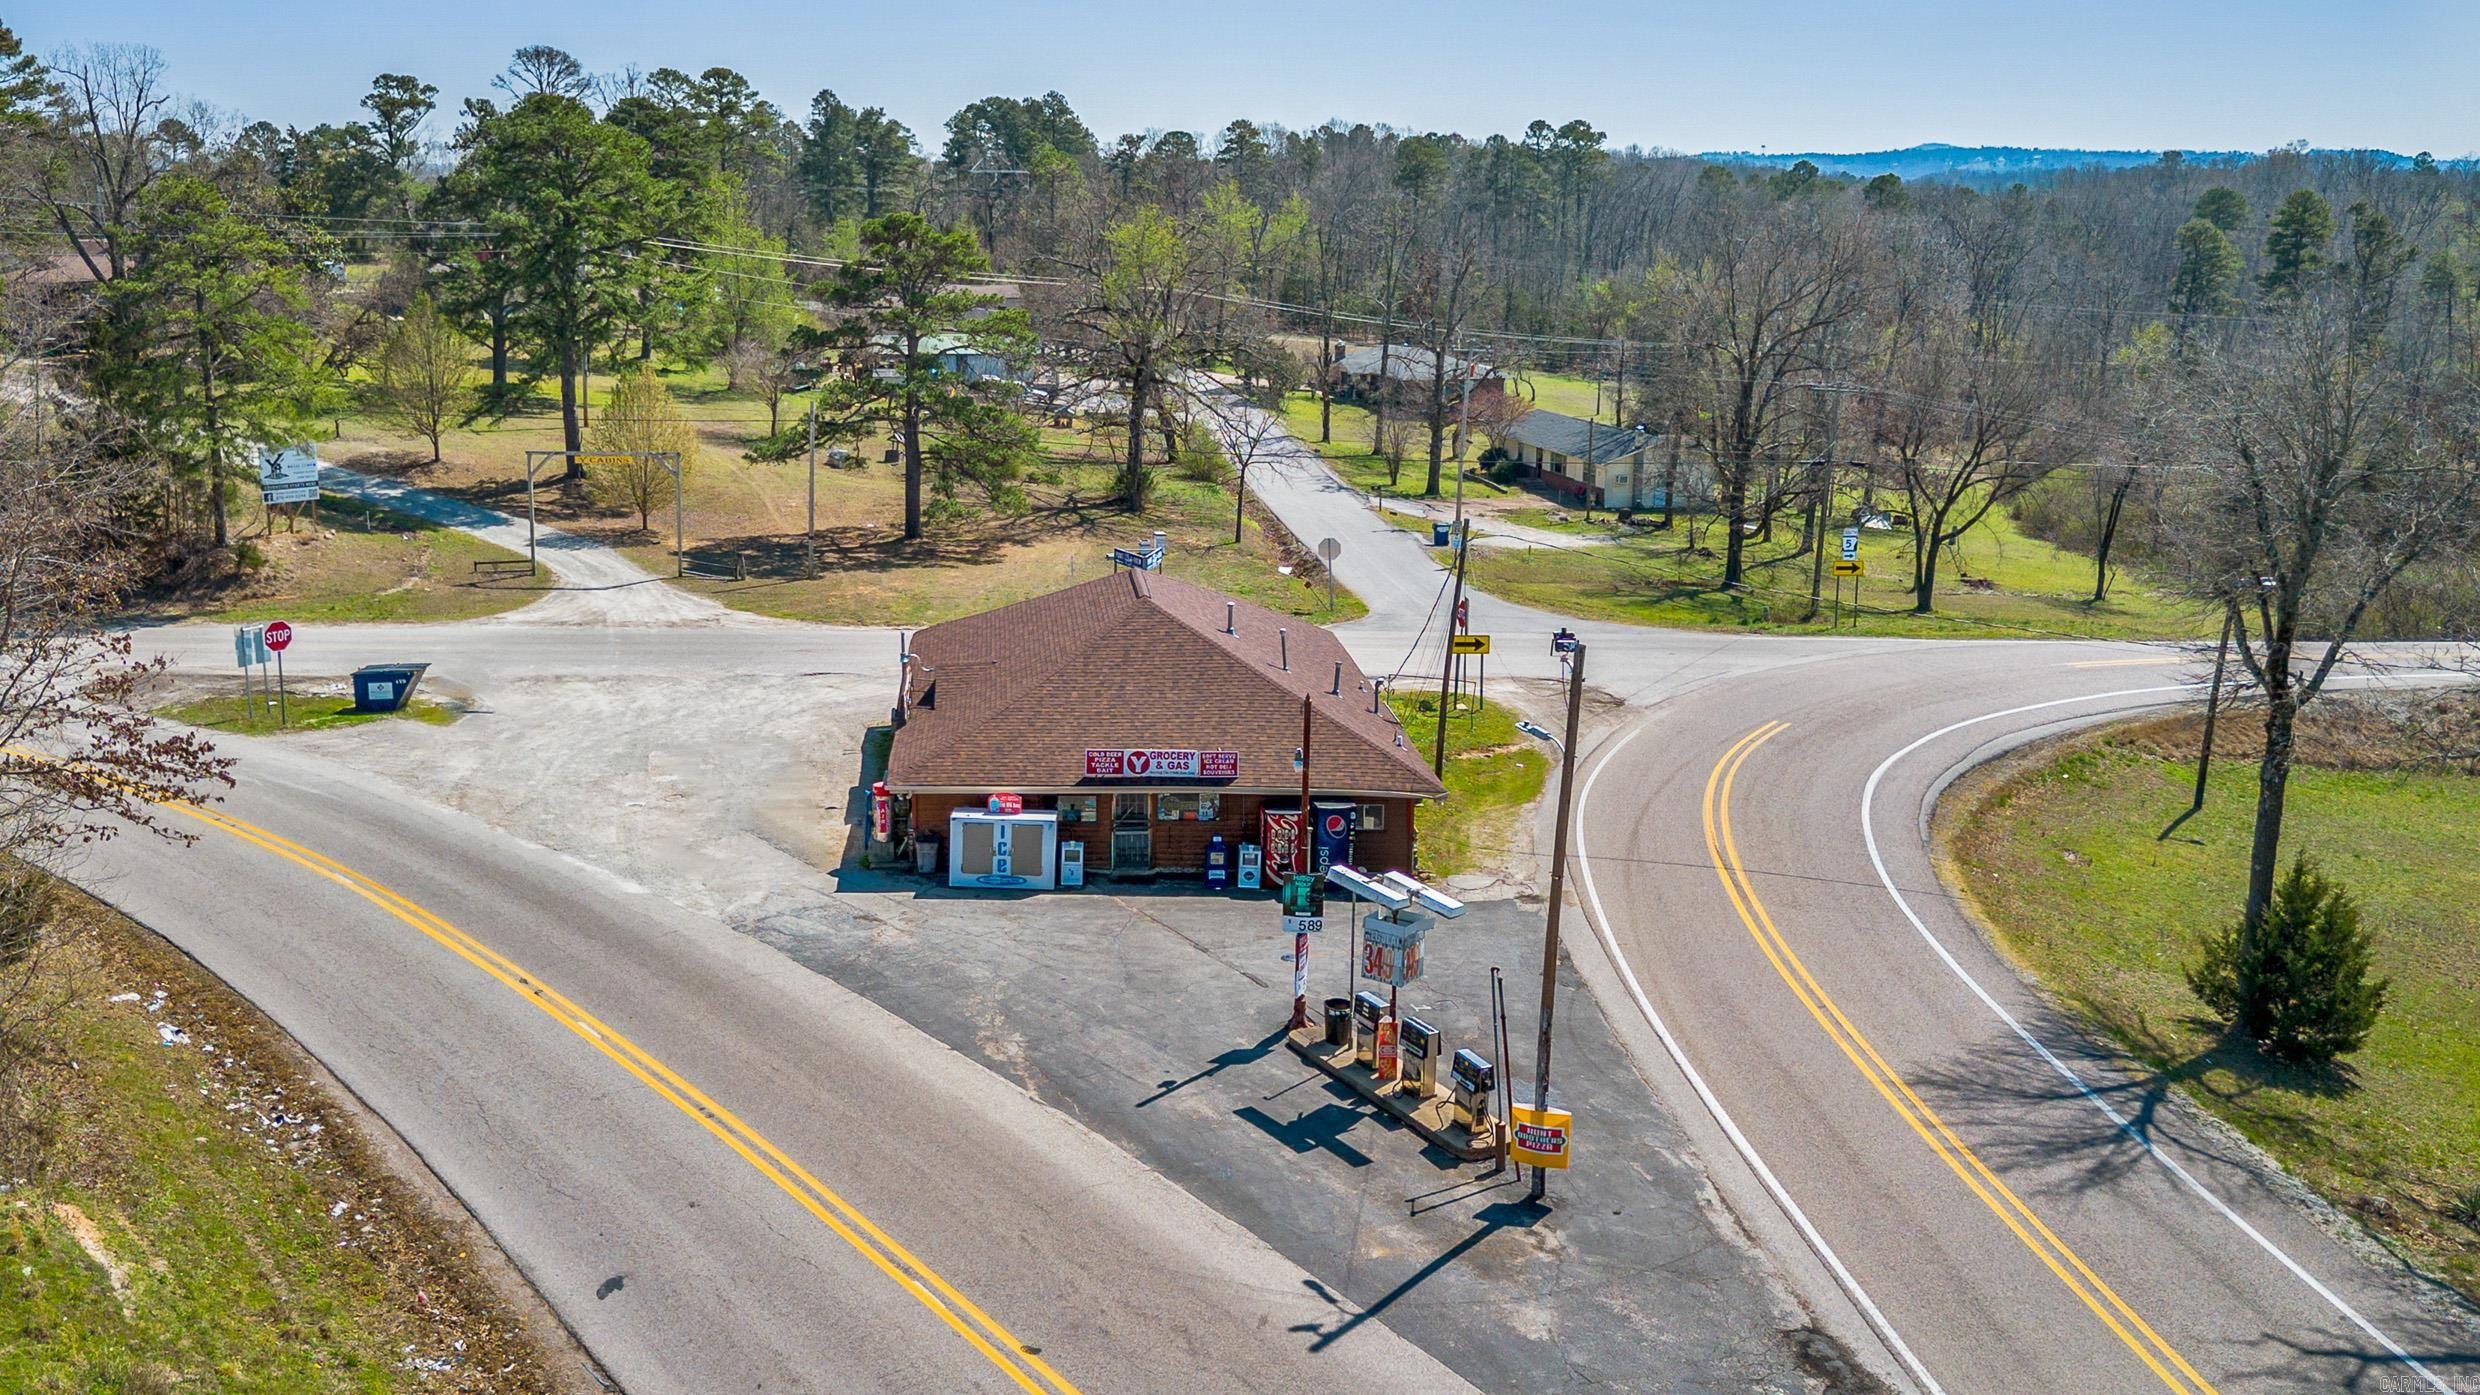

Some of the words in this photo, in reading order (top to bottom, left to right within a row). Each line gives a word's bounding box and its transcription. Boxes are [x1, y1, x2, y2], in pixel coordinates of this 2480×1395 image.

[1845, 539, 1852, 548] 5
[266, 630, 291, 644] STOP
[1150, 751, 1196, 760] GROCERY
[1130, 756, 1147, 773] Y
[1156, 761, 1163, 769] &
[1167, 761, 1190, 770] GAS
[1319, 846, 1331, 873] epsi
[1298, 920, 1323, 931] 589
[1525, 1140, 1553, 1151] PIZZA
